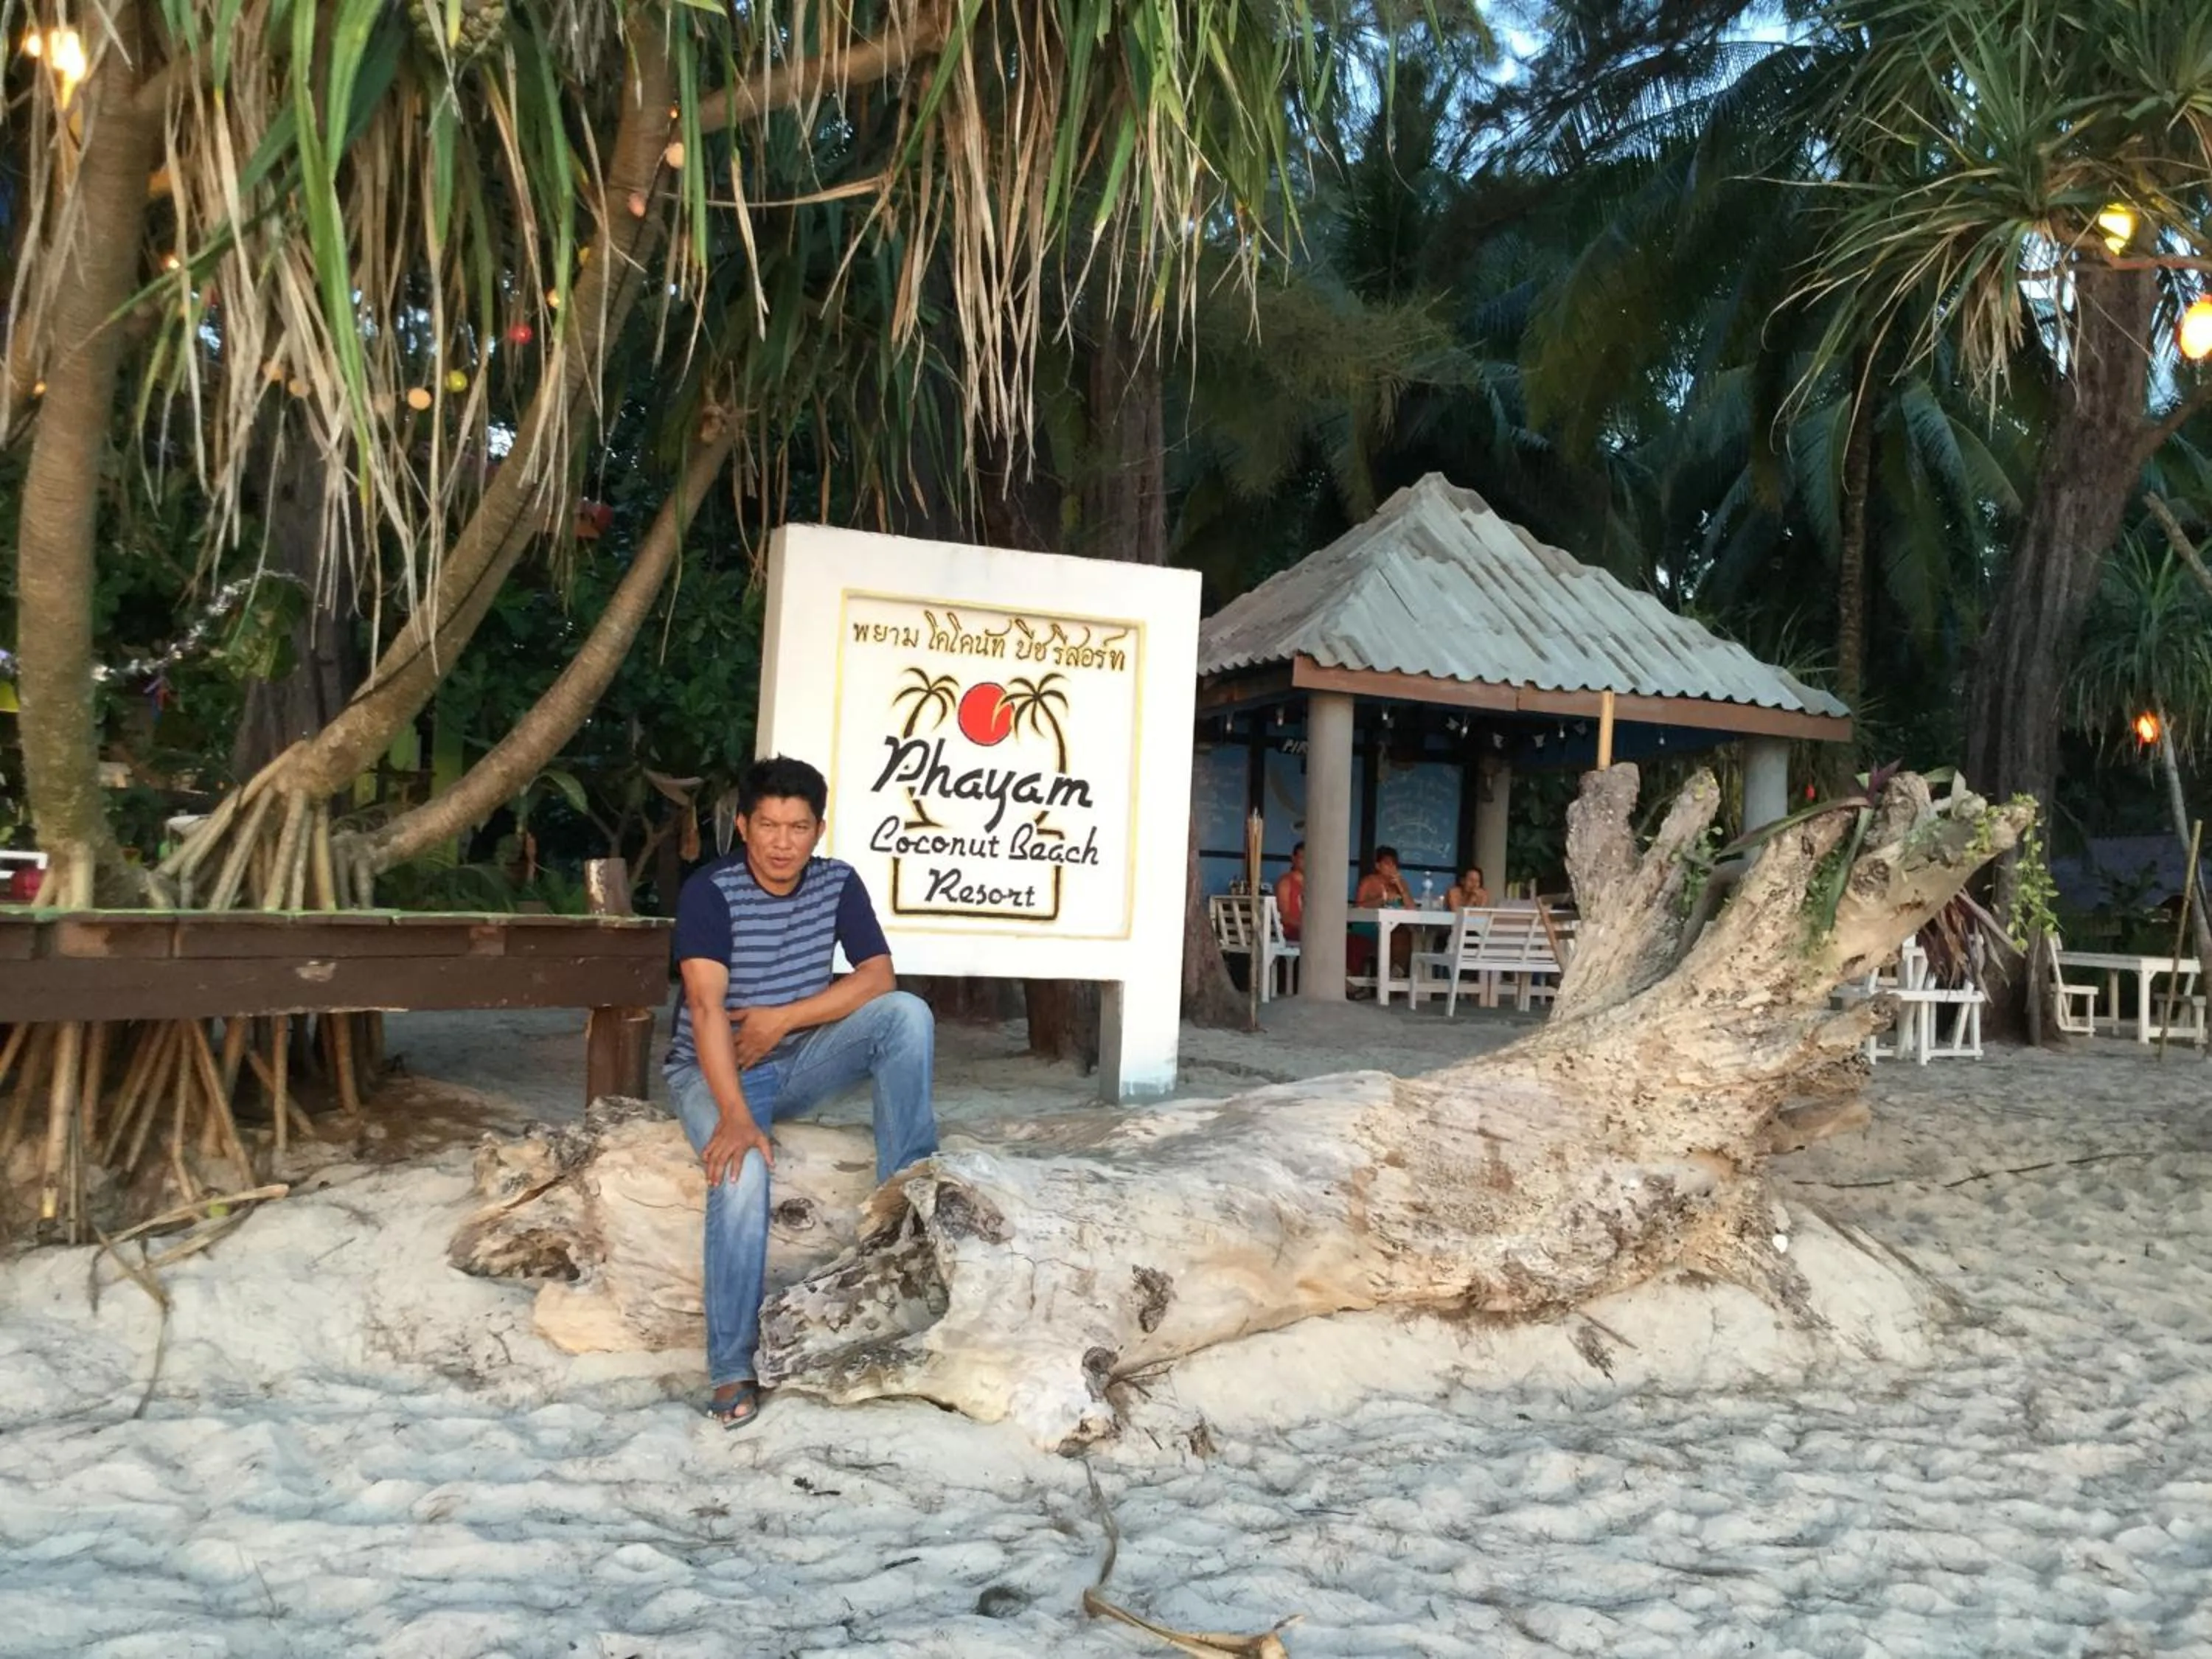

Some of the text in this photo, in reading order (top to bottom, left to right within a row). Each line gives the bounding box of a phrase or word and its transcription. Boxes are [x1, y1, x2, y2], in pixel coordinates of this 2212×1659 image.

[870, 735, 1093, 833] Phayam
[870, 815, 1099, 866] Coconut Beach
[924, 868, 1036, 907] Resort
